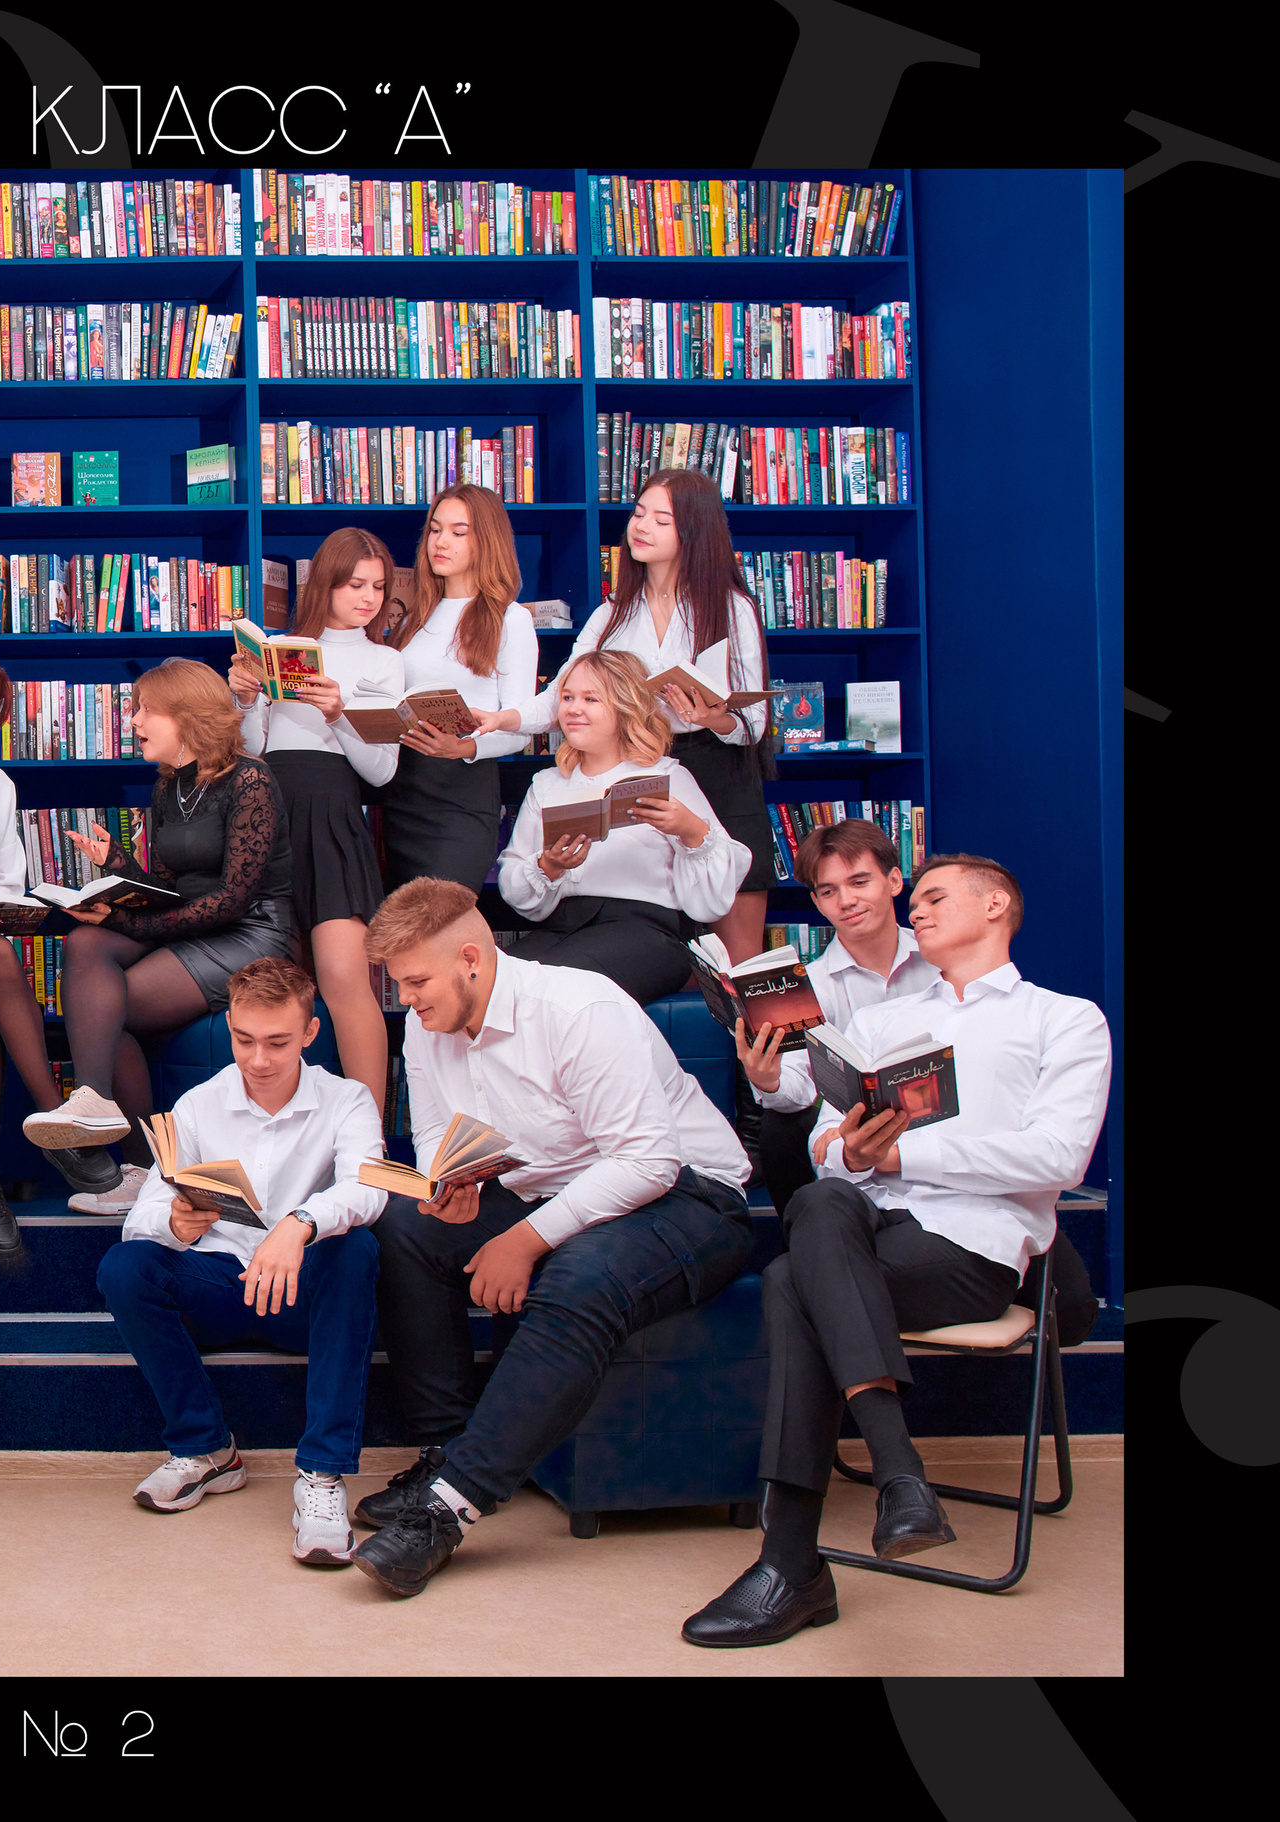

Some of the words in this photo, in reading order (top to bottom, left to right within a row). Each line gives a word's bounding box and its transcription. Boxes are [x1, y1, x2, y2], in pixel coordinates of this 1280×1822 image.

[306, 216, 316, 230] РУА
[325, 323, 333, 349] ЛЕОНАРД
[394, 427, 401, 437] НЕ
[852, 460, 865, 495] НОРФОЛК
[28, 556, 36, 578] КУНЦ
[29, 579, 38, 595] ДИН
[876, 583, 886, 621] ДЕЛИРИУМ
